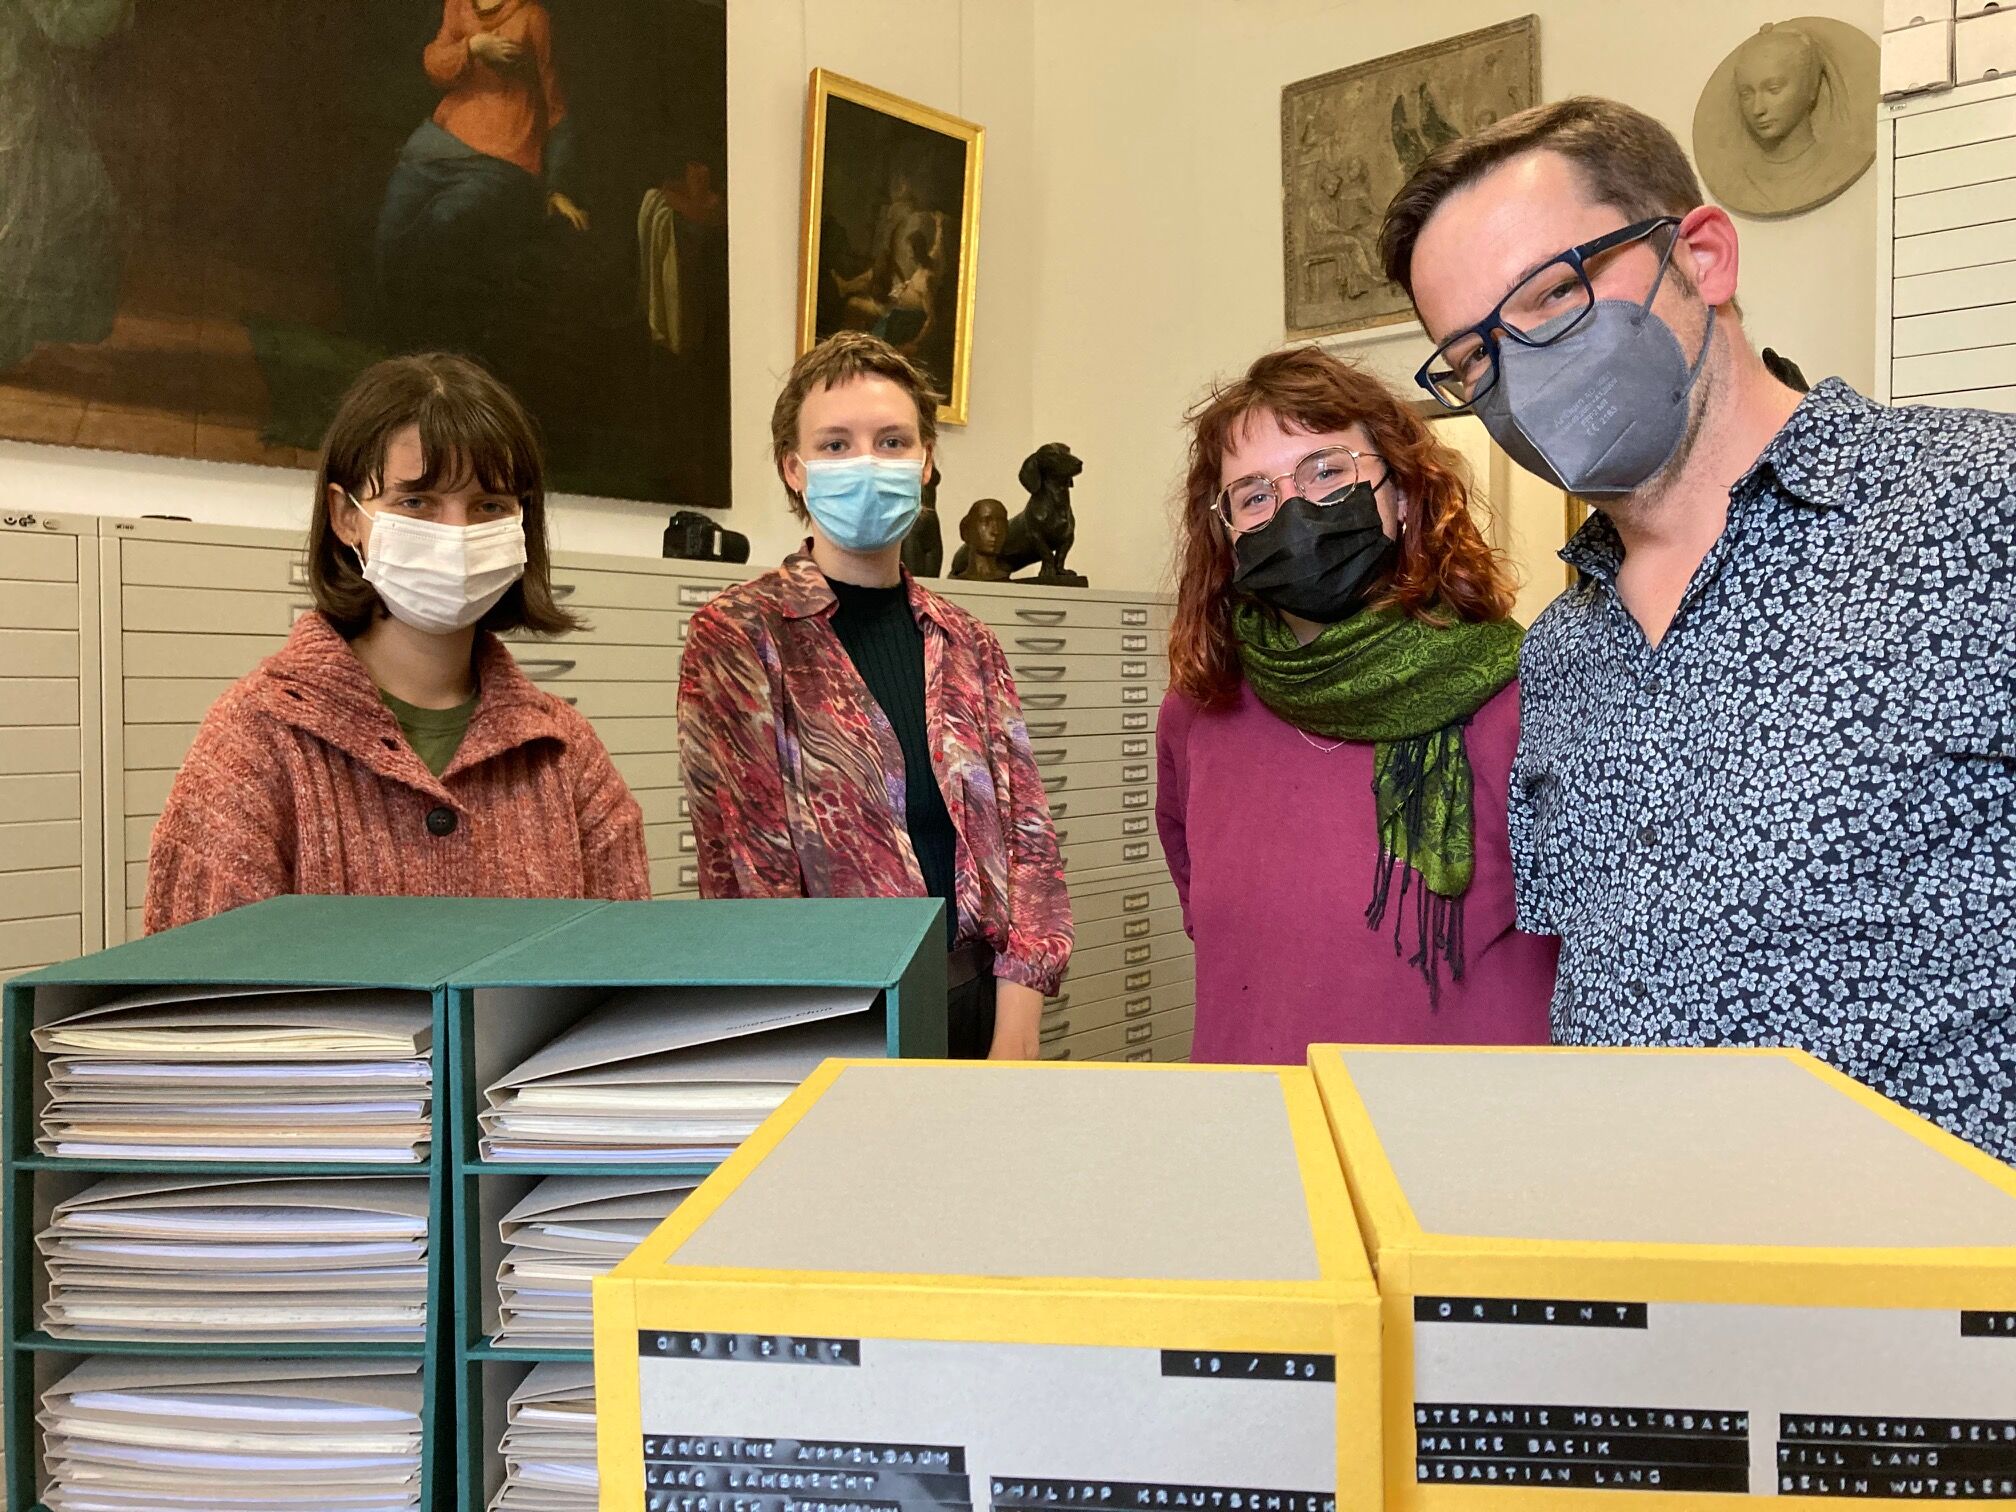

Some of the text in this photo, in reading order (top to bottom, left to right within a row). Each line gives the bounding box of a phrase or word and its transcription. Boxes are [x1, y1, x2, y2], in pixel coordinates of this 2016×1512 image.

[1438, 1302, 1628, 1321] ORIENT
[657, 1336, 842, 1358] ORIENT
[1416, 1409, 1748, 1431] STEPANIE HOLLERBACH
[1786, 1421, 1925, 1437] ANNALENA
[645, 1439, 949, 1465] CAROLINE APPELBAUM
[1421, 1437, 1610, 1455] MAIKE BACIK
[1780, 1449, 1939, 1467] TILL LANG
[647, 1470, 875, 1491] LARS LAMBRECHT
[1417, 1463, 1661, 1484] SEBASTIAN LANG
[993, 1483, 1335, 1512] PHILIPP KRAUTSCHICK
